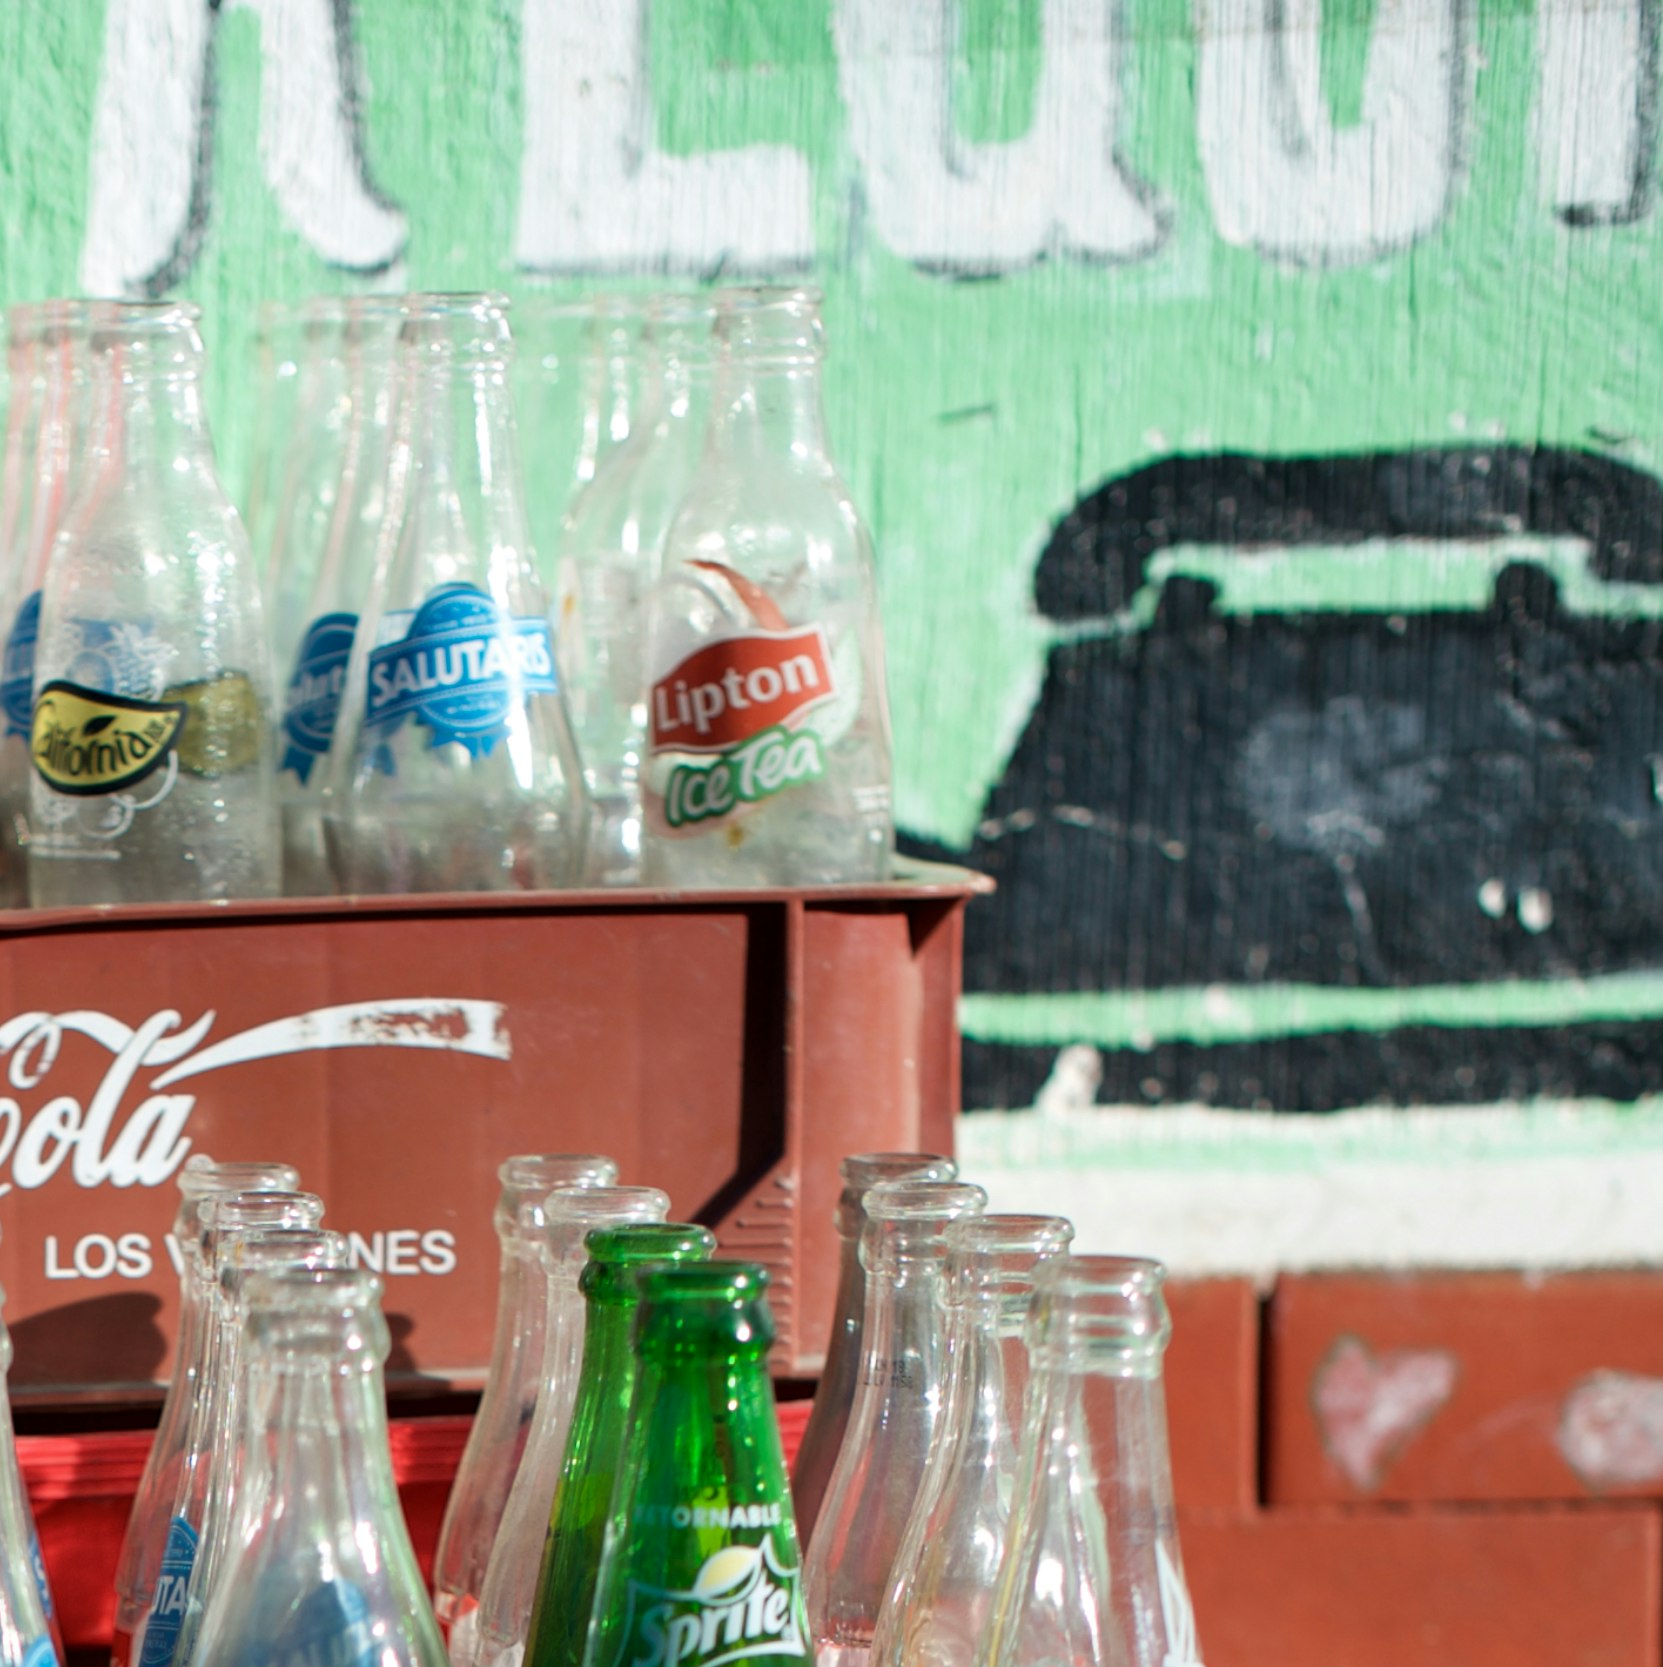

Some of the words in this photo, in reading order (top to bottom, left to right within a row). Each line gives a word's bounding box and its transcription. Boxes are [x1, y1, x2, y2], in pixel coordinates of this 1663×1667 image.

[655, 654, 820, 734] Lipton
[669, 765, 733, 822] Ice
[731, 730, 823, 797] Tea
[44, 1234, 152, 1280] LOS
[164, 1230, 457, 1277] VNES
